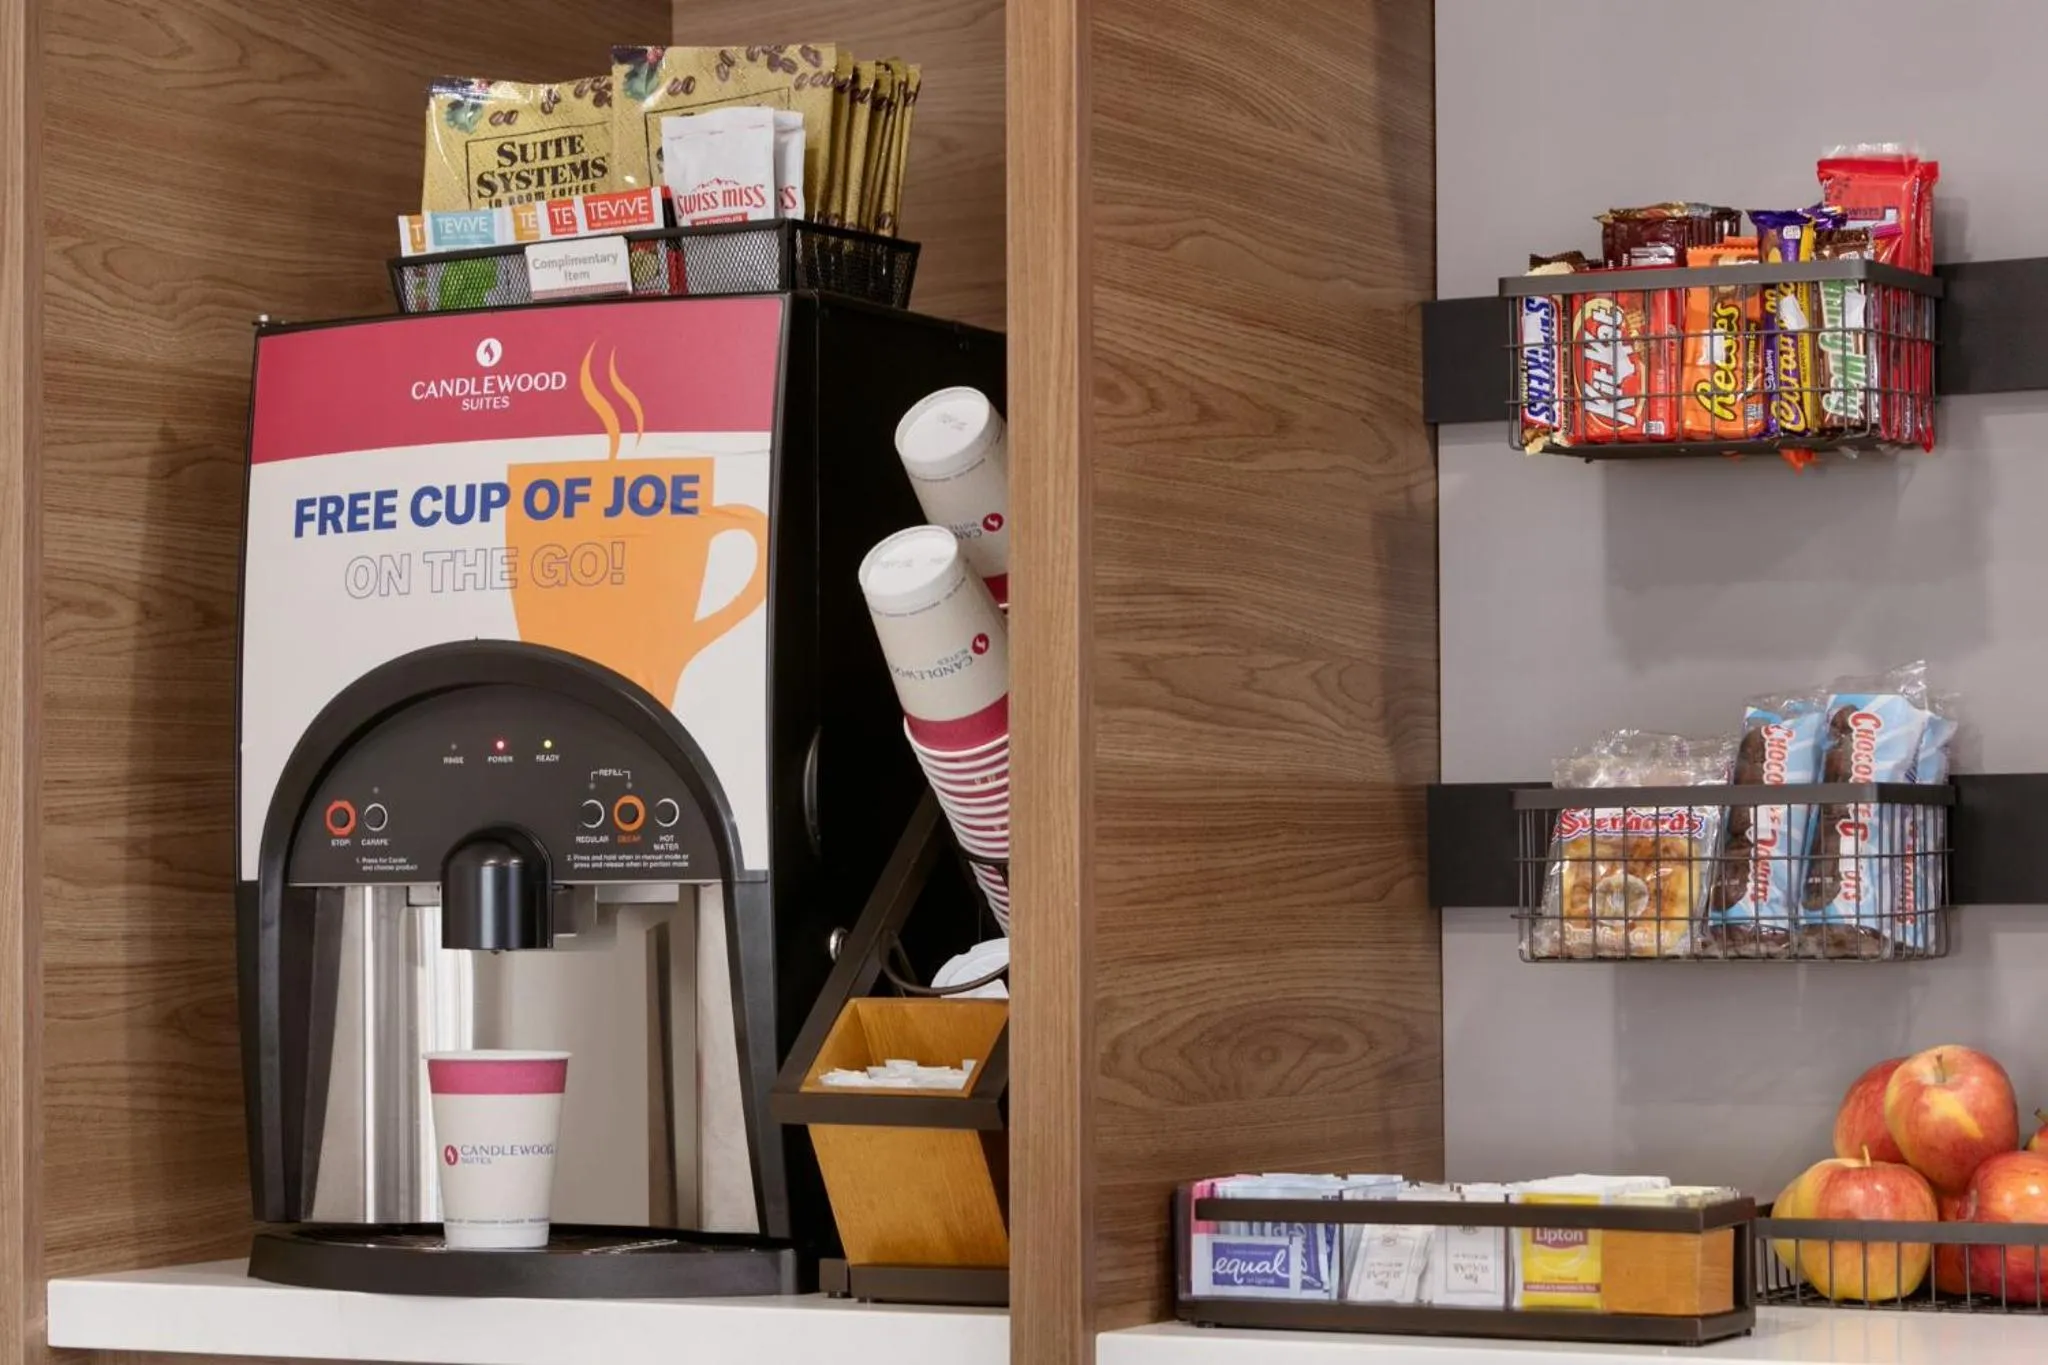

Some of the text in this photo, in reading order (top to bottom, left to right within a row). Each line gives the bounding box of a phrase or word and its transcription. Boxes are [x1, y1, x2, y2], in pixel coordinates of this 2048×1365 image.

[496, 134, 585, 168] SUITE
[476, 156, 608, 198] SYSTEMS
[552, 183, 597, 198] COFFEE
[676, 190, 719, 218] SWISS
[722, 183, 766, 208] MISS
[531, 252, 619, 270] Complimentary
[563, 269, 591, 281] Item
[411, 371, 567, 400] CANDLEWOOD
[462, 396, 510, 411] SUITES
[294, 474, 700, 538] FREE CUP OF JOE
[344, 541, 626, 599] ON THE GO!
[487, 755, 513, 763] POWER
[536, 754, 560, 763] READY
[331, 839, 351, 847] STOP
[576, 835, 610, 844] REGULAR
[659, 834, 675, 842] HOT
[653, 843, 679, 851] WATER
[1536, 1226, 1584, 1245] Lipton
[1213, 1248, 1290, 1285] equal
